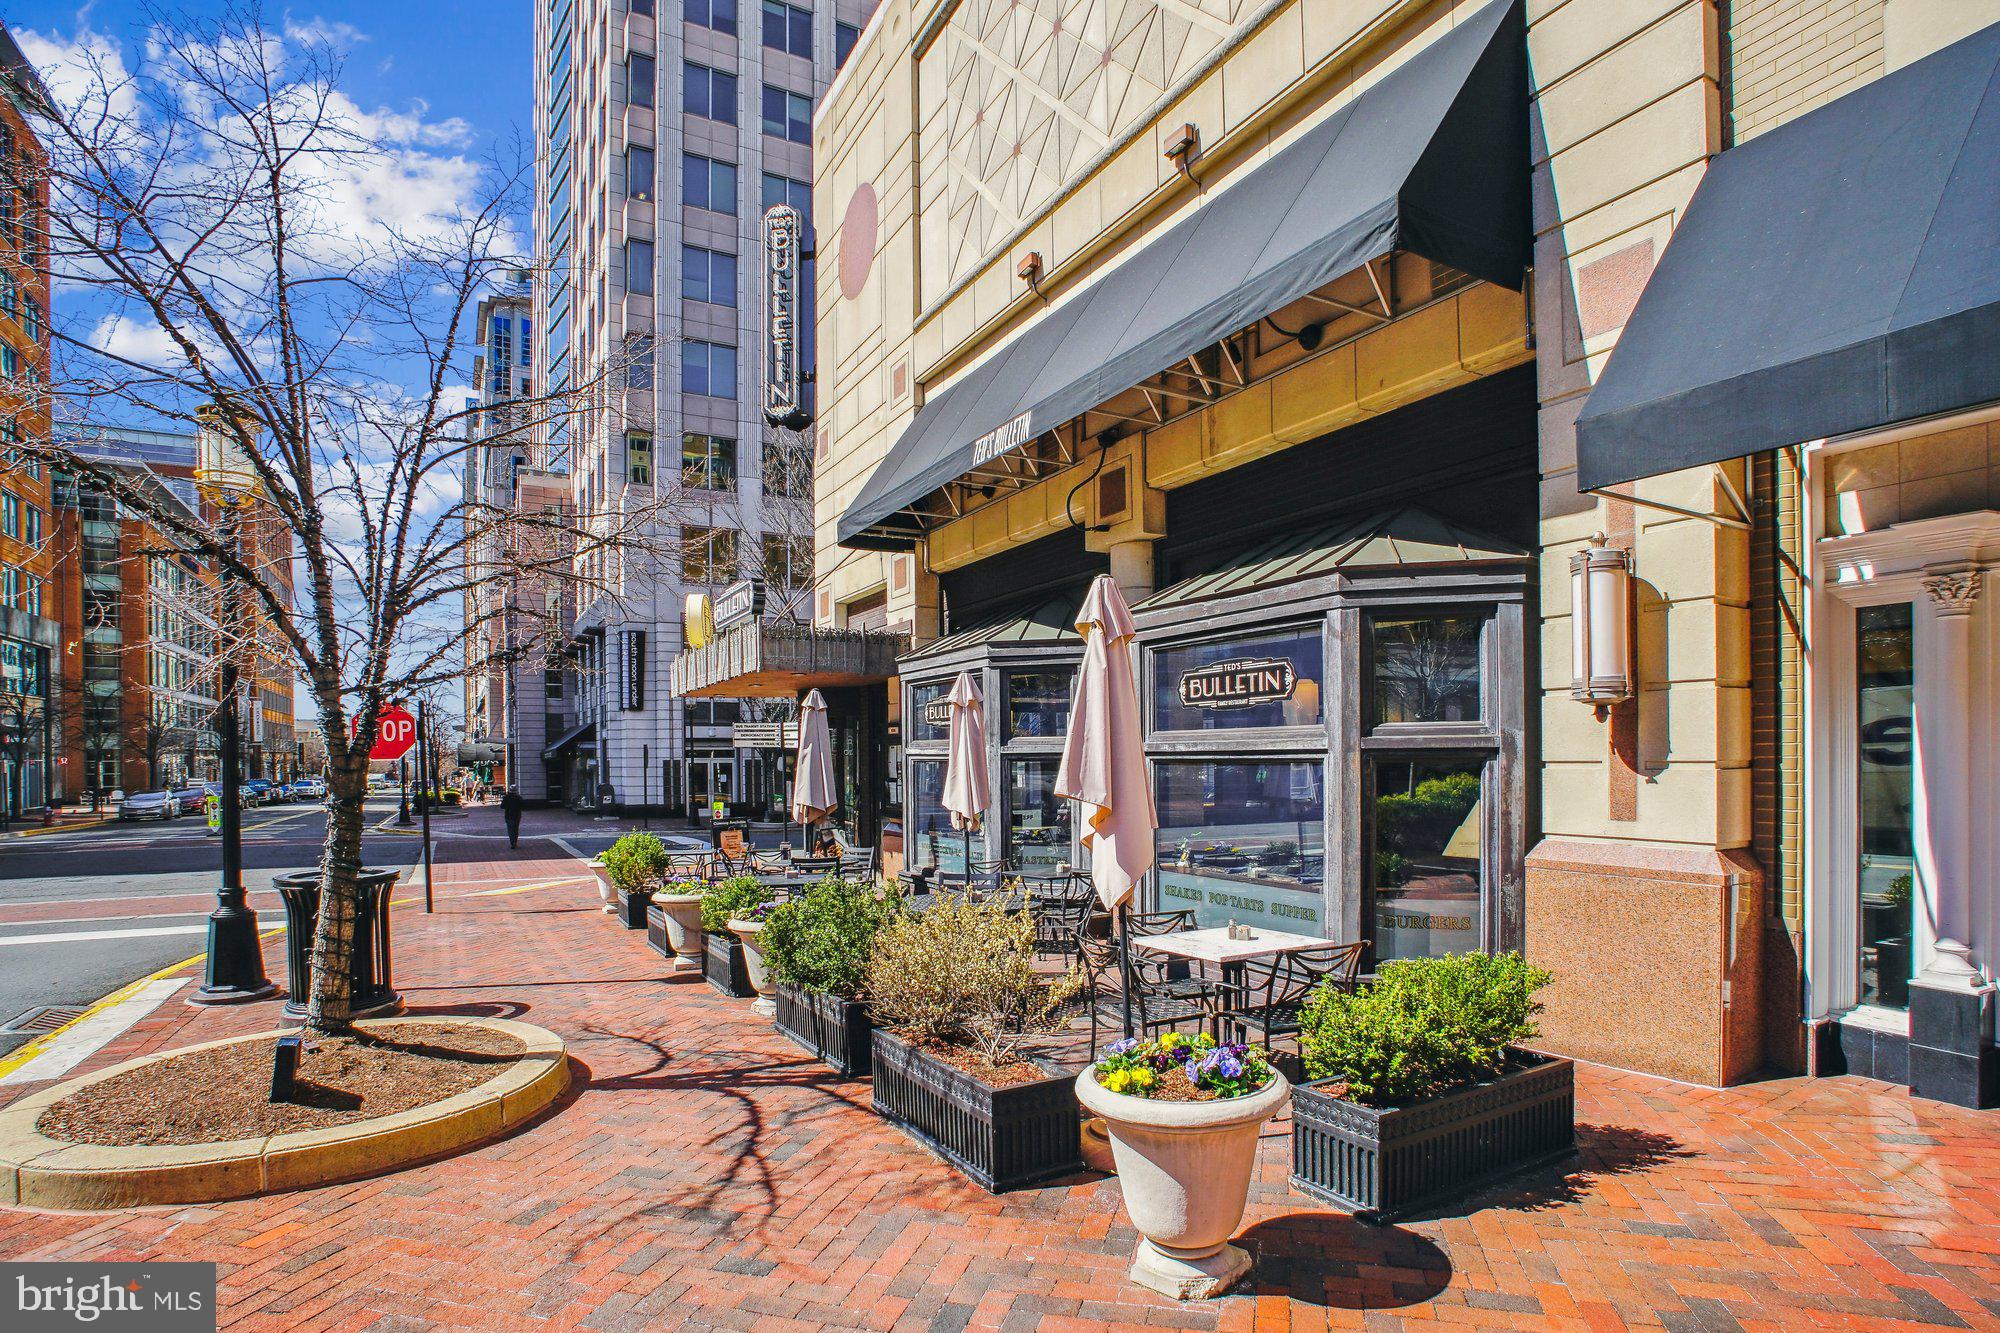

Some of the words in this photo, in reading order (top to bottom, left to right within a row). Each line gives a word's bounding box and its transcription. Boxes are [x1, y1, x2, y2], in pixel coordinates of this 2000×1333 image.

[770, 228, 790, 405] BULLETIN
[973, 431, 995, 466] TED'S
[994, 410, 1032, 456] BULLETIN
[630, 632, 638, 657] south
[1223, 662, 1242, 672] TED'S
[631, 682, 639, 707] under
[1189, 669, 1281, 699] BULLETIN
[929, 705, 951, 720] BULL
[381, 719, 412, 742] OP
[1164, 884, 1203, 901] SHAKES
[1271, 902, 1317, 922] SUPPER
[1383, 914, 1472, 931] BURGERS
